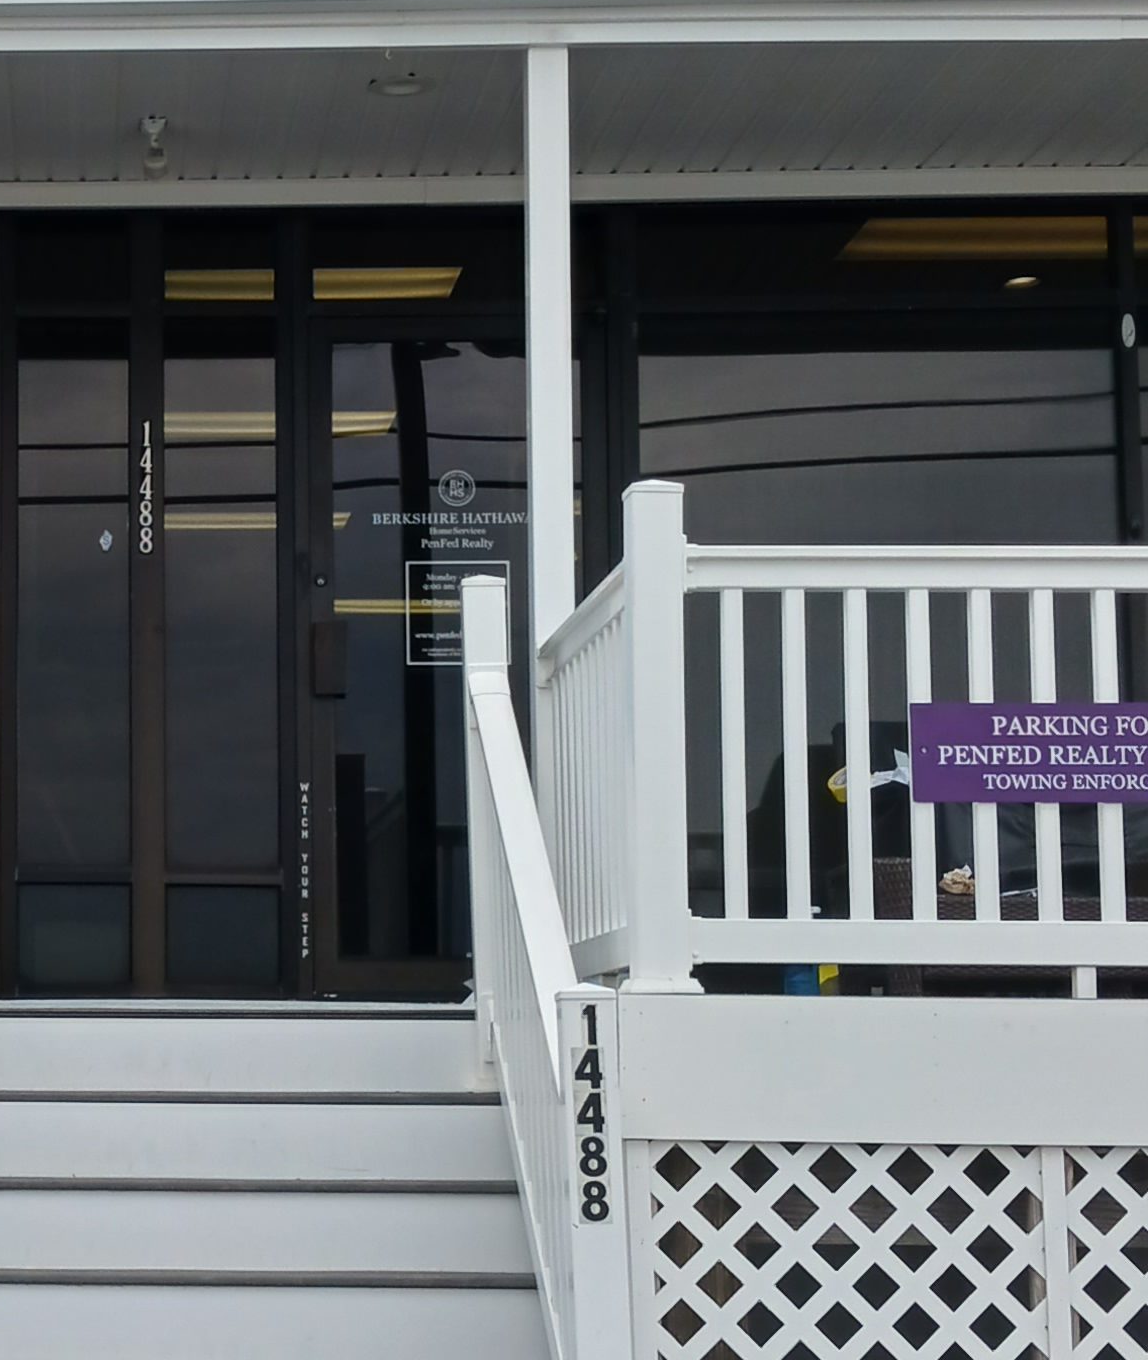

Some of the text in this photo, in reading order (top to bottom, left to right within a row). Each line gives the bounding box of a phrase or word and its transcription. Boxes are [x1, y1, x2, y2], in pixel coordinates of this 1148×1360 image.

[139, 420, 153, 554] 14488
[372, 512, 459, 525] BERKSHIRE
[429, 526, 487, 536] HomeServices
[421, 537, 495, 551] PenFed Realty
[991, 715, 1148, 737] PARKING FO
[938, 745, 1148, 766] PENFED REALTY
[983, 773, 1148, 791] TOWING ENFORC
[299, 782, 310, 959] WATCH YOUR STEP
[574, 1004, 610, 1222] 14488
